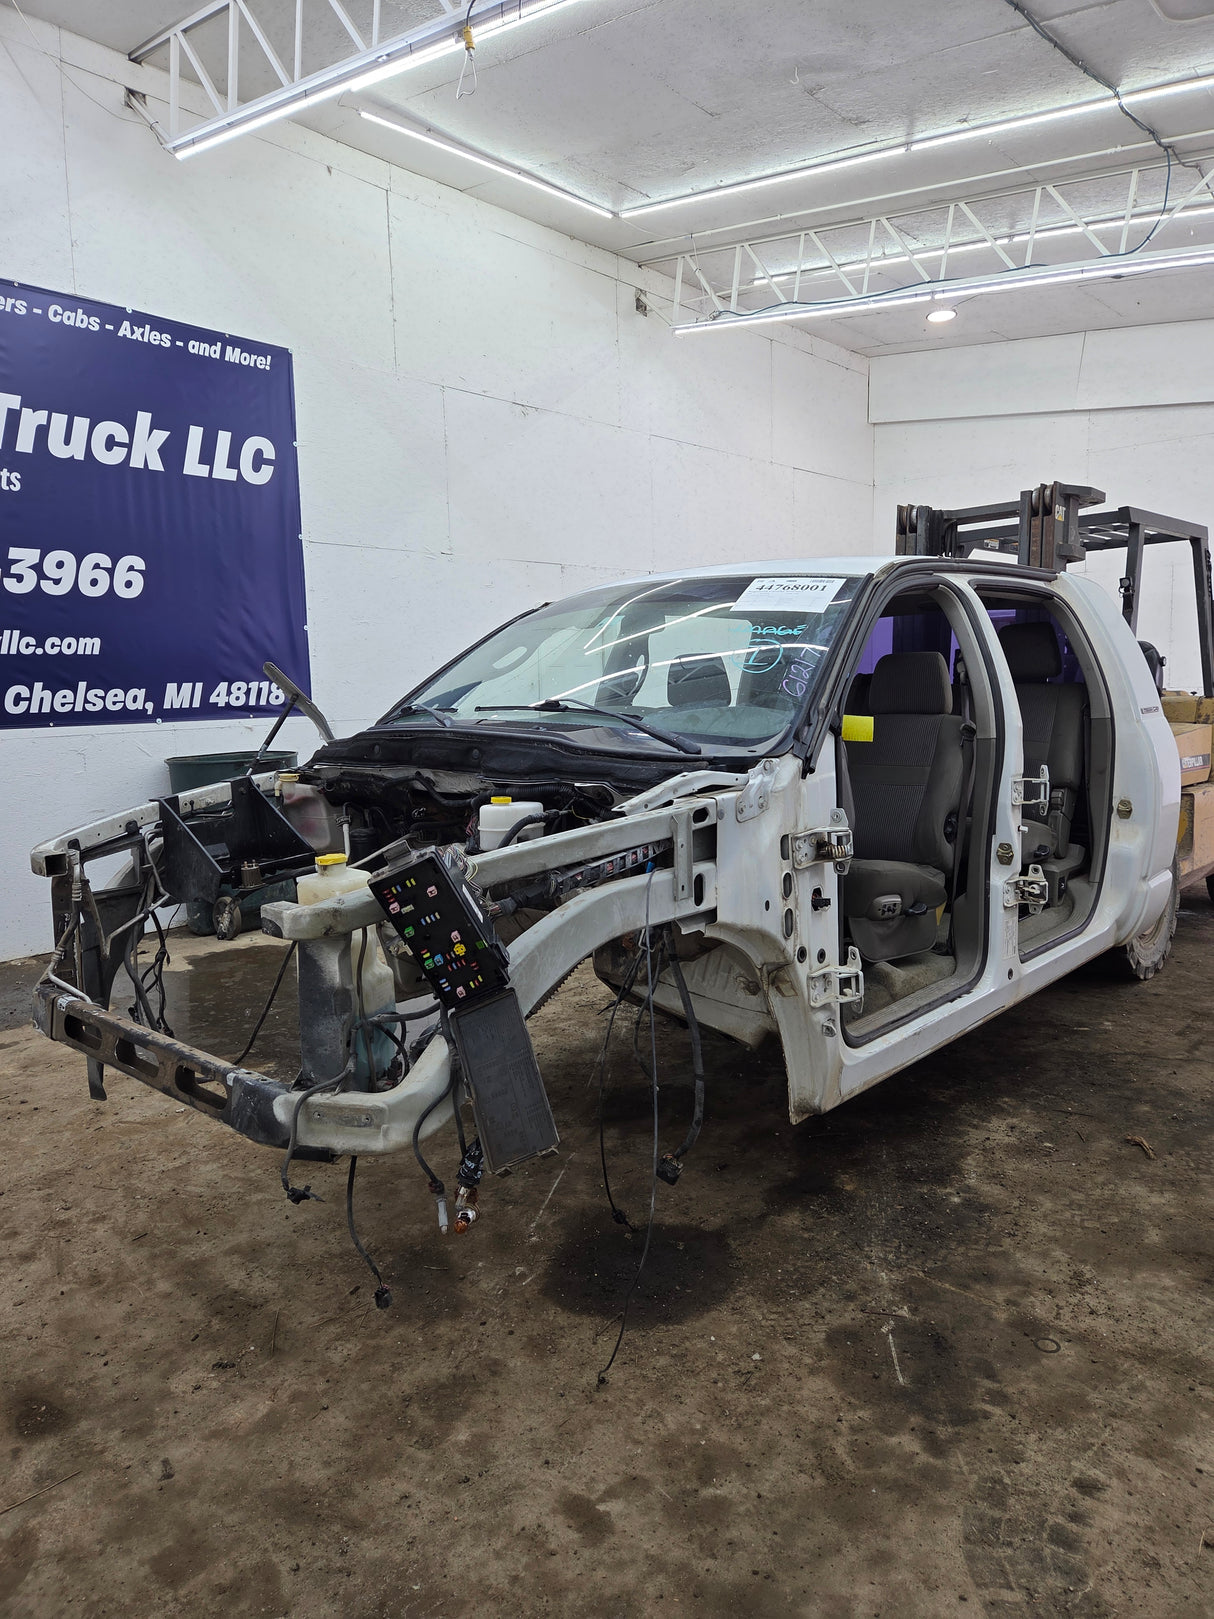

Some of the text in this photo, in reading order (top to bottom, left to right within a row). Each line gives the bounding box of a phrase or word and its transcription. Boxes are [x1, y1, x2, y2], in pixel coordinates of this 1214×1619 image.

[47, 304, 101, 332] Cabs
[117, 320, 172, 348] Axles
[187, 339, 222, 360] and
[224, 345, 272, 371] More!
[0, 392, 276, 486] Truck LLC
[755, 584, 827, 592] 44768001
[0, 629, 101, 655] llc.com
[4, 680, 286, 715] Chelsea, MI 48118
